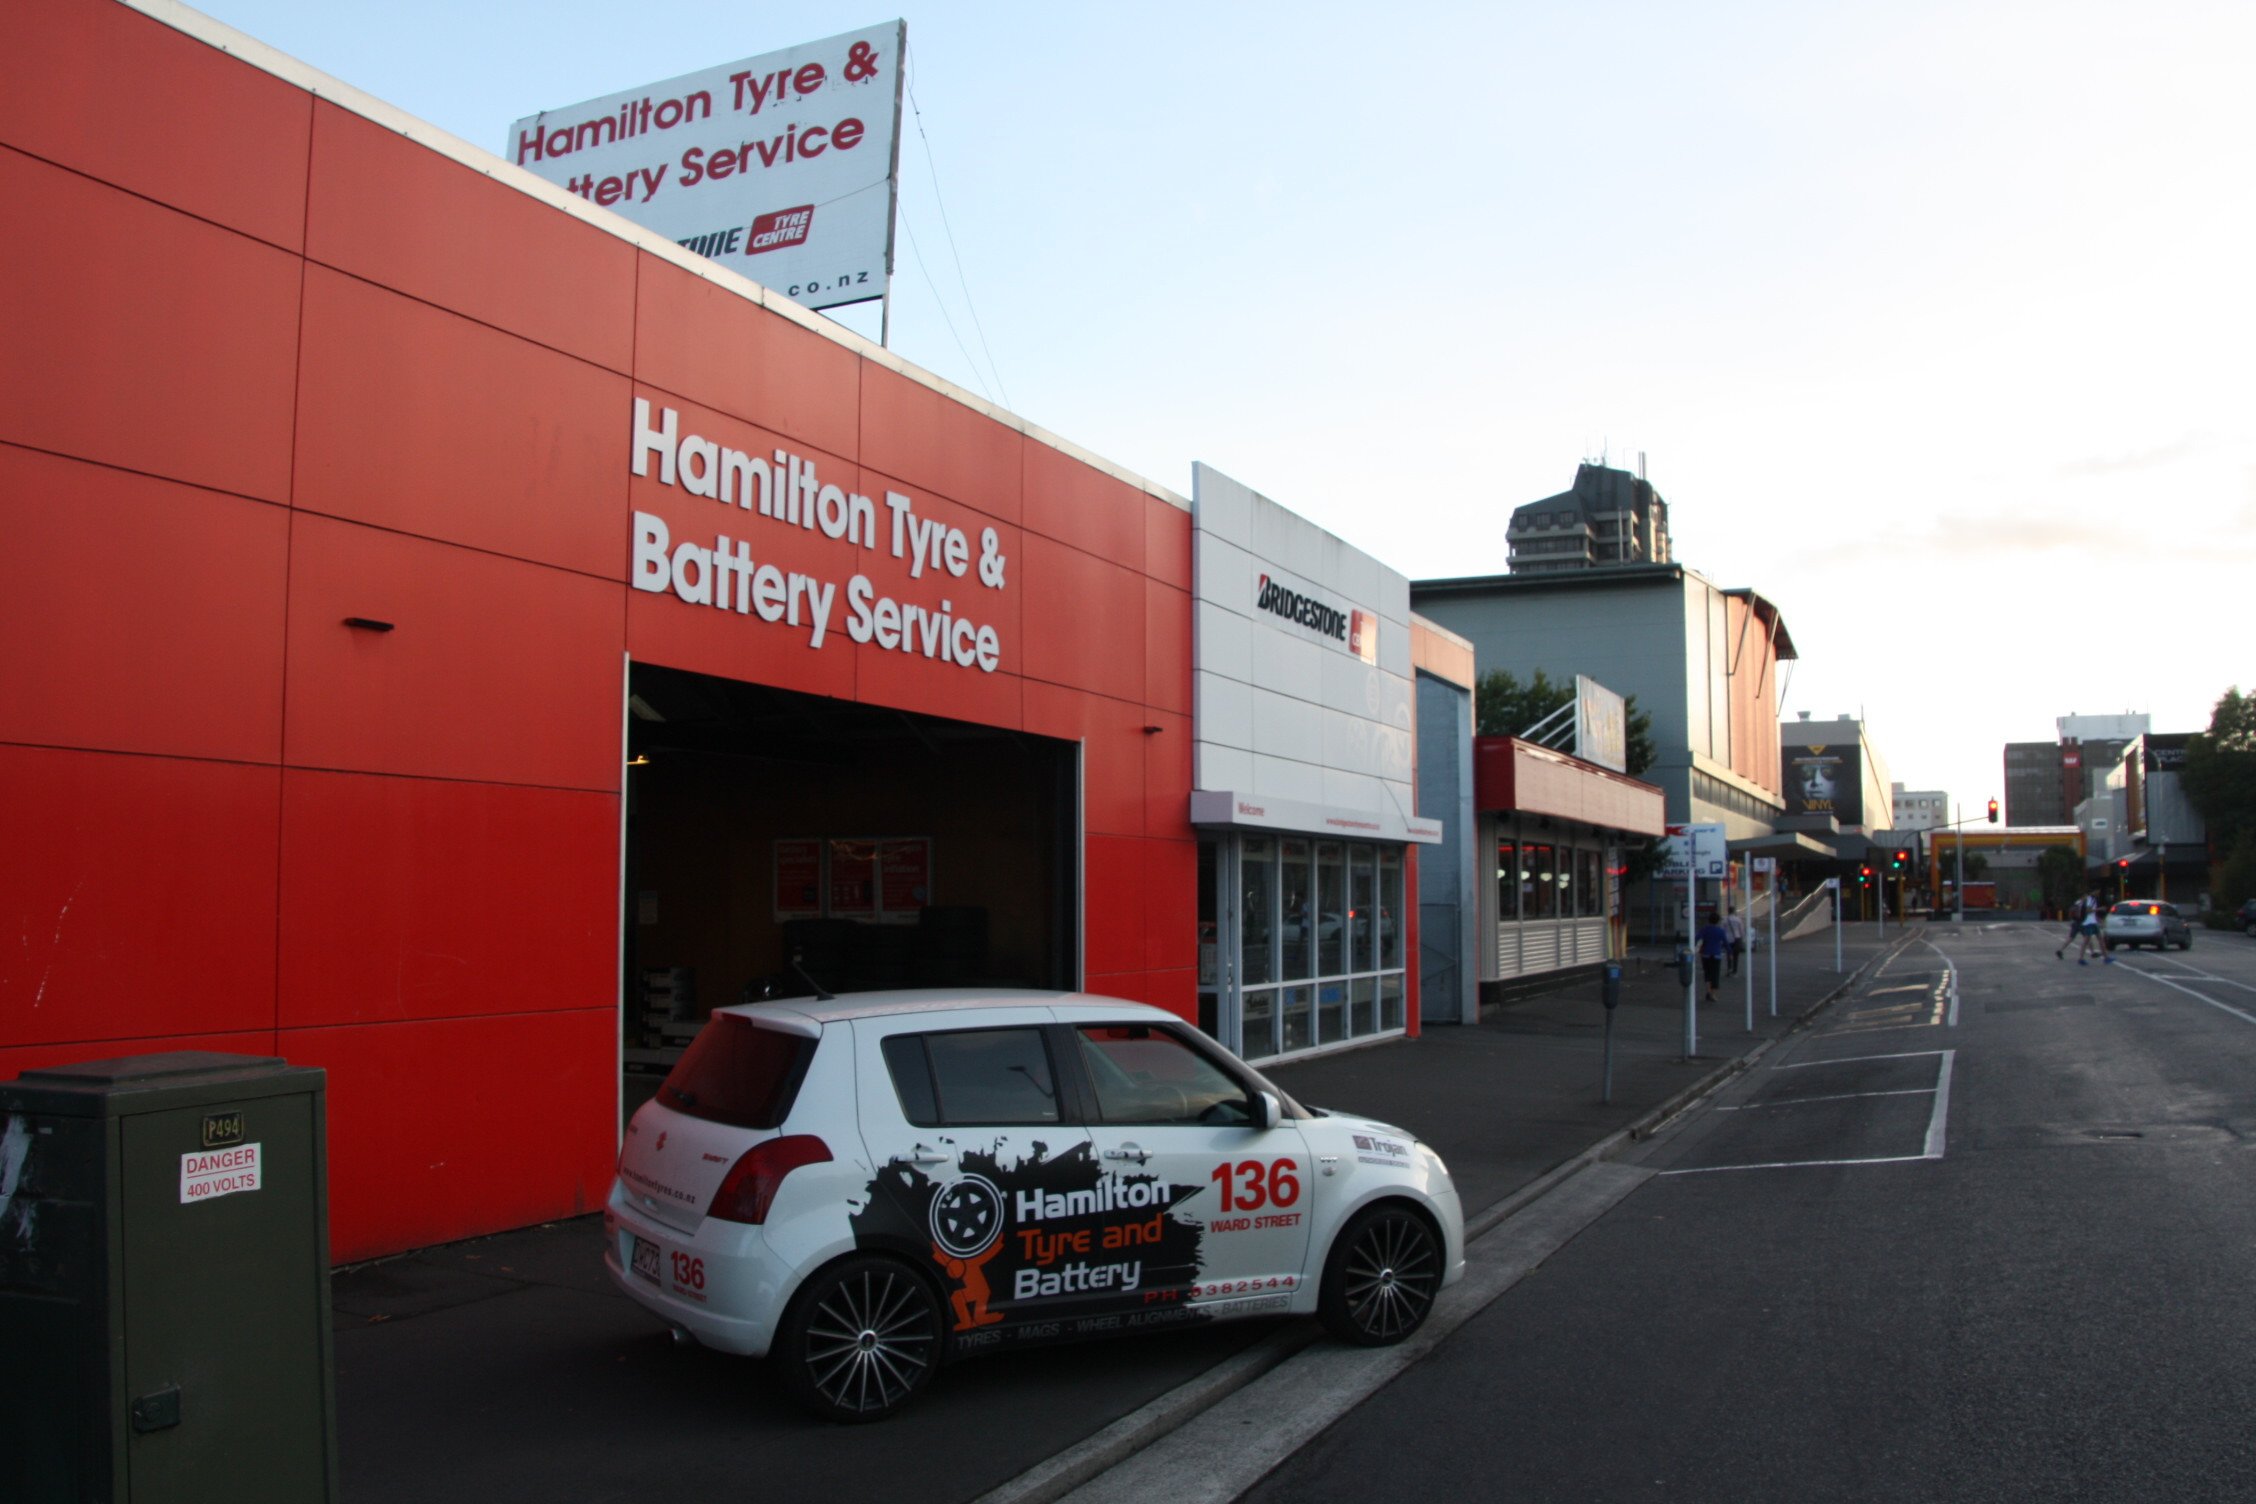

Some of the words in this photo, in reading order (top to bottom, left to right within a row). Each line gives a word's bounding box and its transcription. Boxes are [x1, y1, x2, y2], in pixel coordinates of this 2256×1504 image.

[517, 90, 711, 165] Hamilton
[729, 62, 825, 115] Tyre
[843, 40, 879, 82] &
[567, 163, 668, 206] ttery
[679, 117, 865, 187] Service
[752, 224, 806, 249] CENTRE
[774, 210, 810, 230] TYRE
[631, 396, 876, 550] Hamilton
[885, 490, 970, 579] Tyre
[978, 526, 1006, 590] &
[631, 510, 836, 649] Battery
[846, 574, 1001, 673] Service
[1257, 573, 1347, 642] BRIDGESTONE
[1238, 801, 1265, 817] Welcome
[1801, 799, 1835, 811] VINYL
[208, 1117, 240, 1140] P494
[187, 1148, 255, 1174] DANGER
[187, 1181, 210, 1197] 400
[213, 1174, 255, 1193] VOLTS
[1016, 1178, 1171, 1223] Hamilton
[1211, 1158, 1300, 1213] 136
[1017, 1229, 1091, 1266] Tyre
[1102, 1212, 1164, 1249] and
[1210, 1217, 1251, 1234] WARD
[1253, 1213, 1302, 1230] STREET
[670, 1250, 705, 1290] 136
[1014, 1258, 1142, 1300] Battery
[957, 1329, 1001, 1351] TYRES
[1017, 1322, 1060, 1341] MAGS
[1076, 1313, 1123, 1336] WHEEL
[1126, 1304, 1211, 1330] ALIGNMENTS
[1221, 1295, 1289, 1315] BATTERIES
